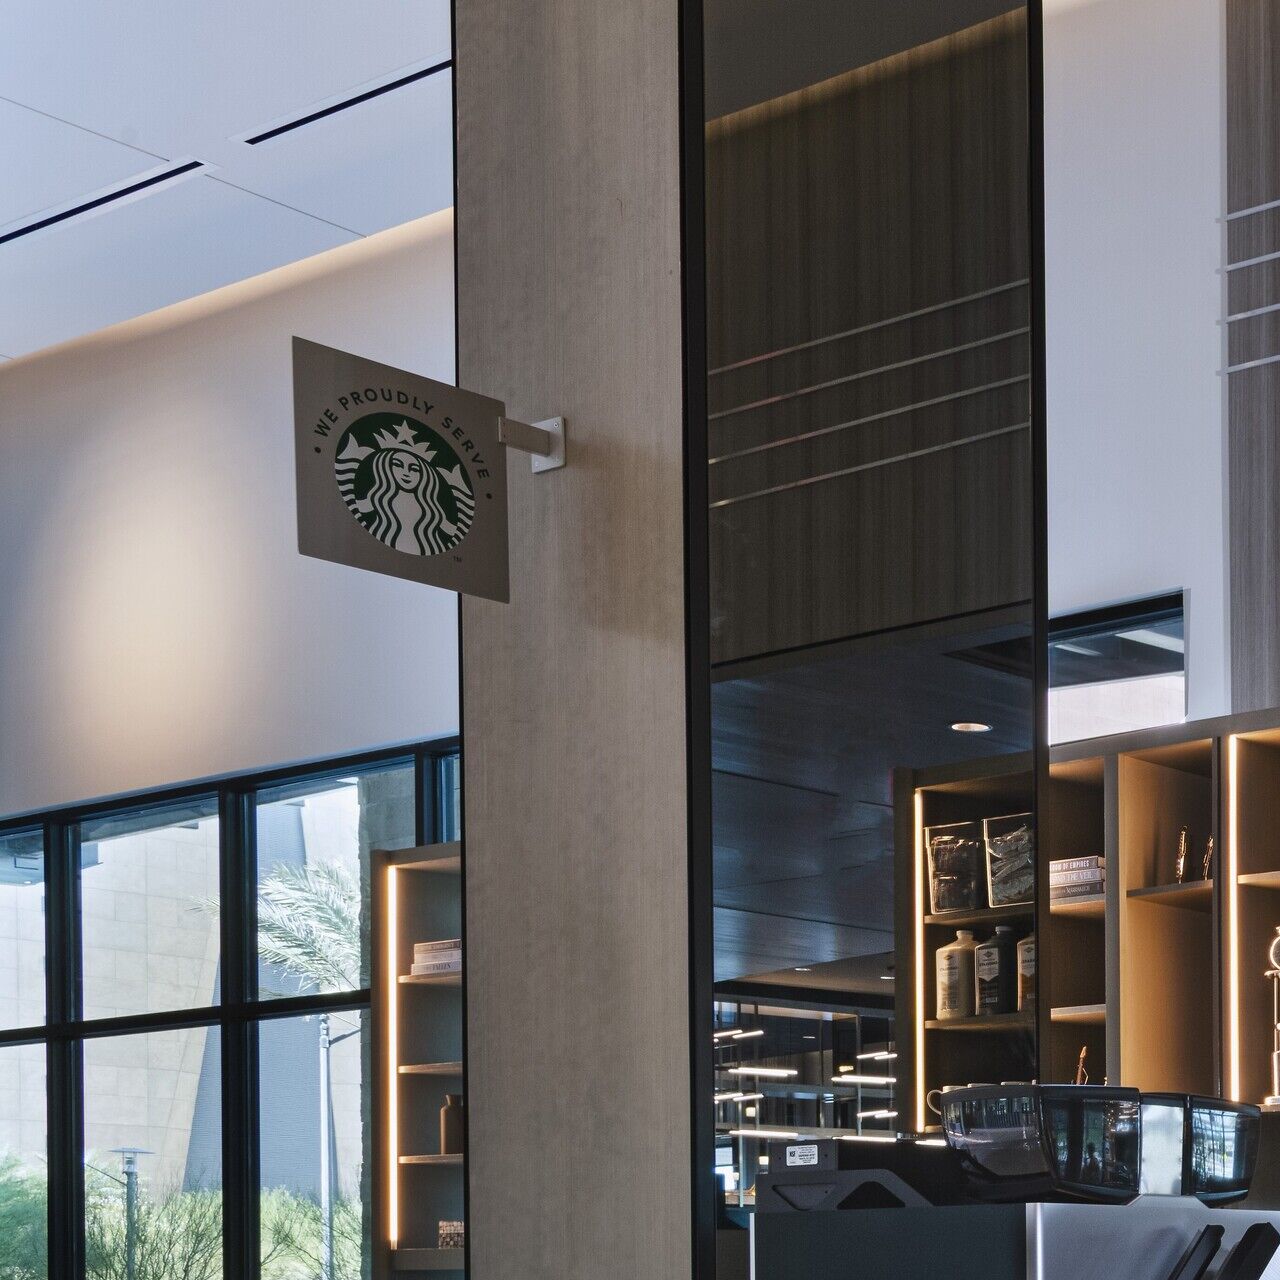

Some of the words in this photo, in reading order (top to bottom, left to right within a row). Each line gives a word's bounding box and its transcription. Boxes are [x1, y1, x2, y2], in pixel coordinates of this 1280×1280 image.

[314, 408, 339, 439] WE
[338, 388, 435, 415] PROUDLY
[441, 416, 490, 480] SERVE
